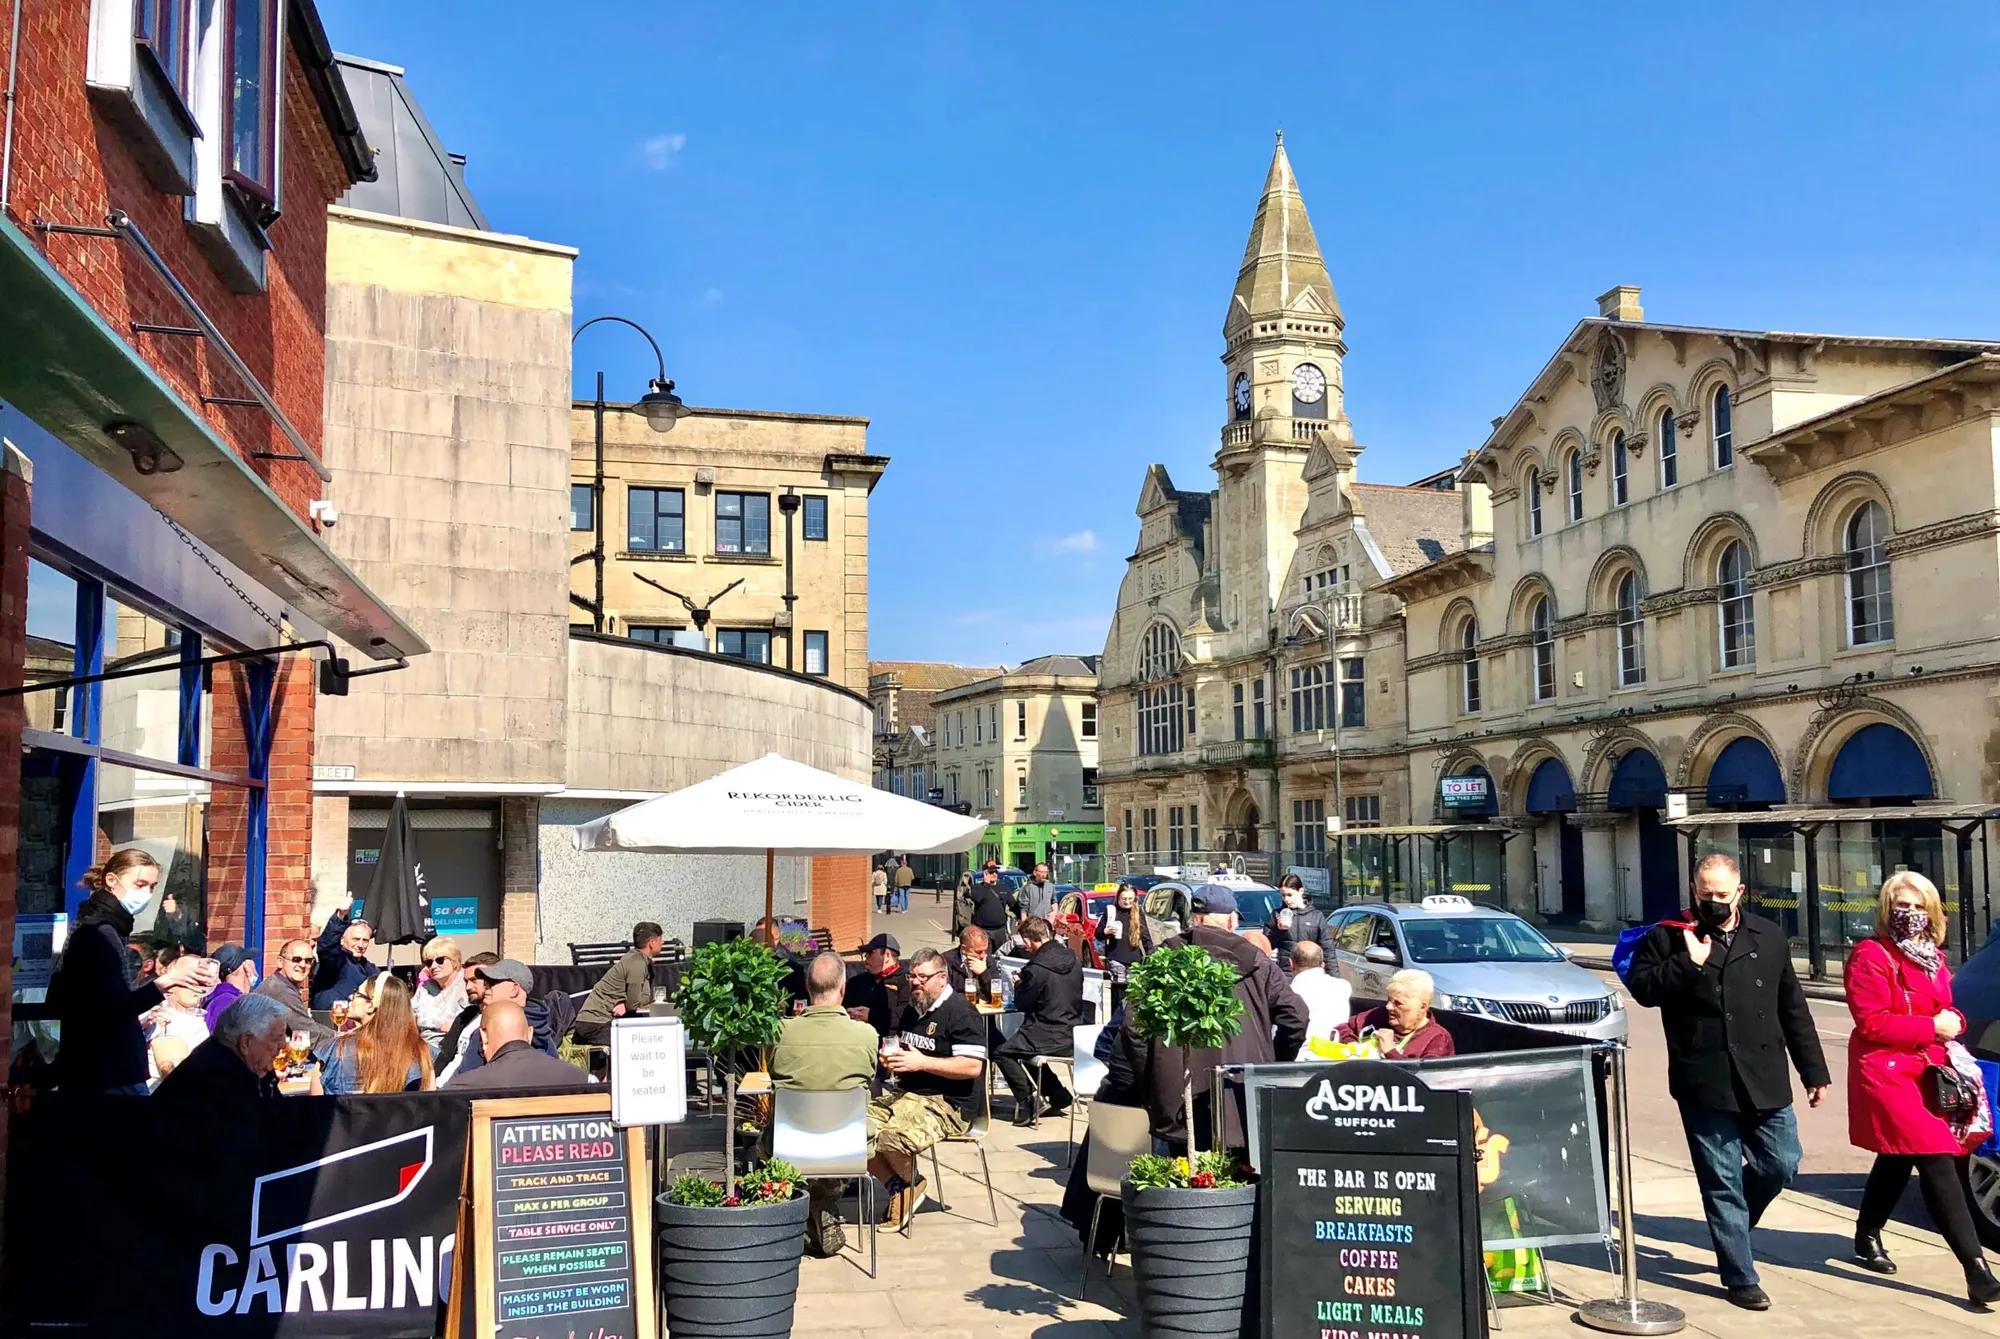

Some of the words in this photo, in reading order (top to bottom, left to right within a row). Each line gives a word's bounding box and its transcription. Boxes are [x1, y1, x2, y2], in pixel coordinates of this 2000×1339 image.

[1446, 784, 1462, 792] TO
[1466, 783, 1482, 792] LET
[728, 792, 862, 802] REKORDERLIG
[434, 906, 474, 916] savers
[632, 1034, 664, 1044] Please
[630, 1052, 652, 1061] wait
[655, 1051, 666, 1060] to
[642, 1068, 655, 1078] be
[632, 1084, 666, 1096] seated
[1306, 1079, 1425, 1121] ASPALL
[1334, 1116, 1396, 1129] SUFFOLK
[502, 1122, 614, 1144] ATTENTION
[502, 1144, 564, 1164] PLEASE
[570, 1142, 614, 1159] READ
[512, 1176, 547, 1188] TRACK
[550, 1174, 574, 1186] AND
[576, 1172, 610, 1183] TRACE
[1298, 1168, 1326, 1188] THE
[1334, 1169, 1366, 1190] BAR
[1374, 1170, 1388, 1190] IS
[1395, 1171, 1436, 1191] OPEN
[514, 1202, 539, 1212] MAX
[542, 1200, 548, 1210] 6
[550, 1199, 570, 1210] PER
[572, 1196, 609, 1208] GROUP
[1335, 1196, 1402, 1217] SERVING
[509, 1226, 543, 1238] TABLE
[544, 1224, 587, 1236] SERVICE
[588, 1221, 616, 1232] ONLY
[1315, 1220, 1414, 1244] BREAKFASTS
[503, 1254, 541, 1265] PLEASE
[543, 1250, 584, 1261] REMAIN
[586, 1246, 623, 1258] SEATED
[1339, 1248, 1399, 1270] COFFEE
[522, 1263, 558, 1274] WHEN
[559, 1260, 606, 1271] POSSIBLE
[503, 1292, 540, 1304] MASKS
[542, 1289, 573, 1301] MUST
[575, 1287, 588, 1298] BE
[590, 1283, 625, 1295] WORN
[1344, 1275, 1396, 1297] CAKES
[508, 1304, 544, 1317] INSIDE
[546, 1300, 569, 1312] THE
[571, 1296, 621, 1309] BUILDING
[1317, 1301, 1362, 1322] LIGHT
[1370, 1304, 1424, 1326] MEALS
